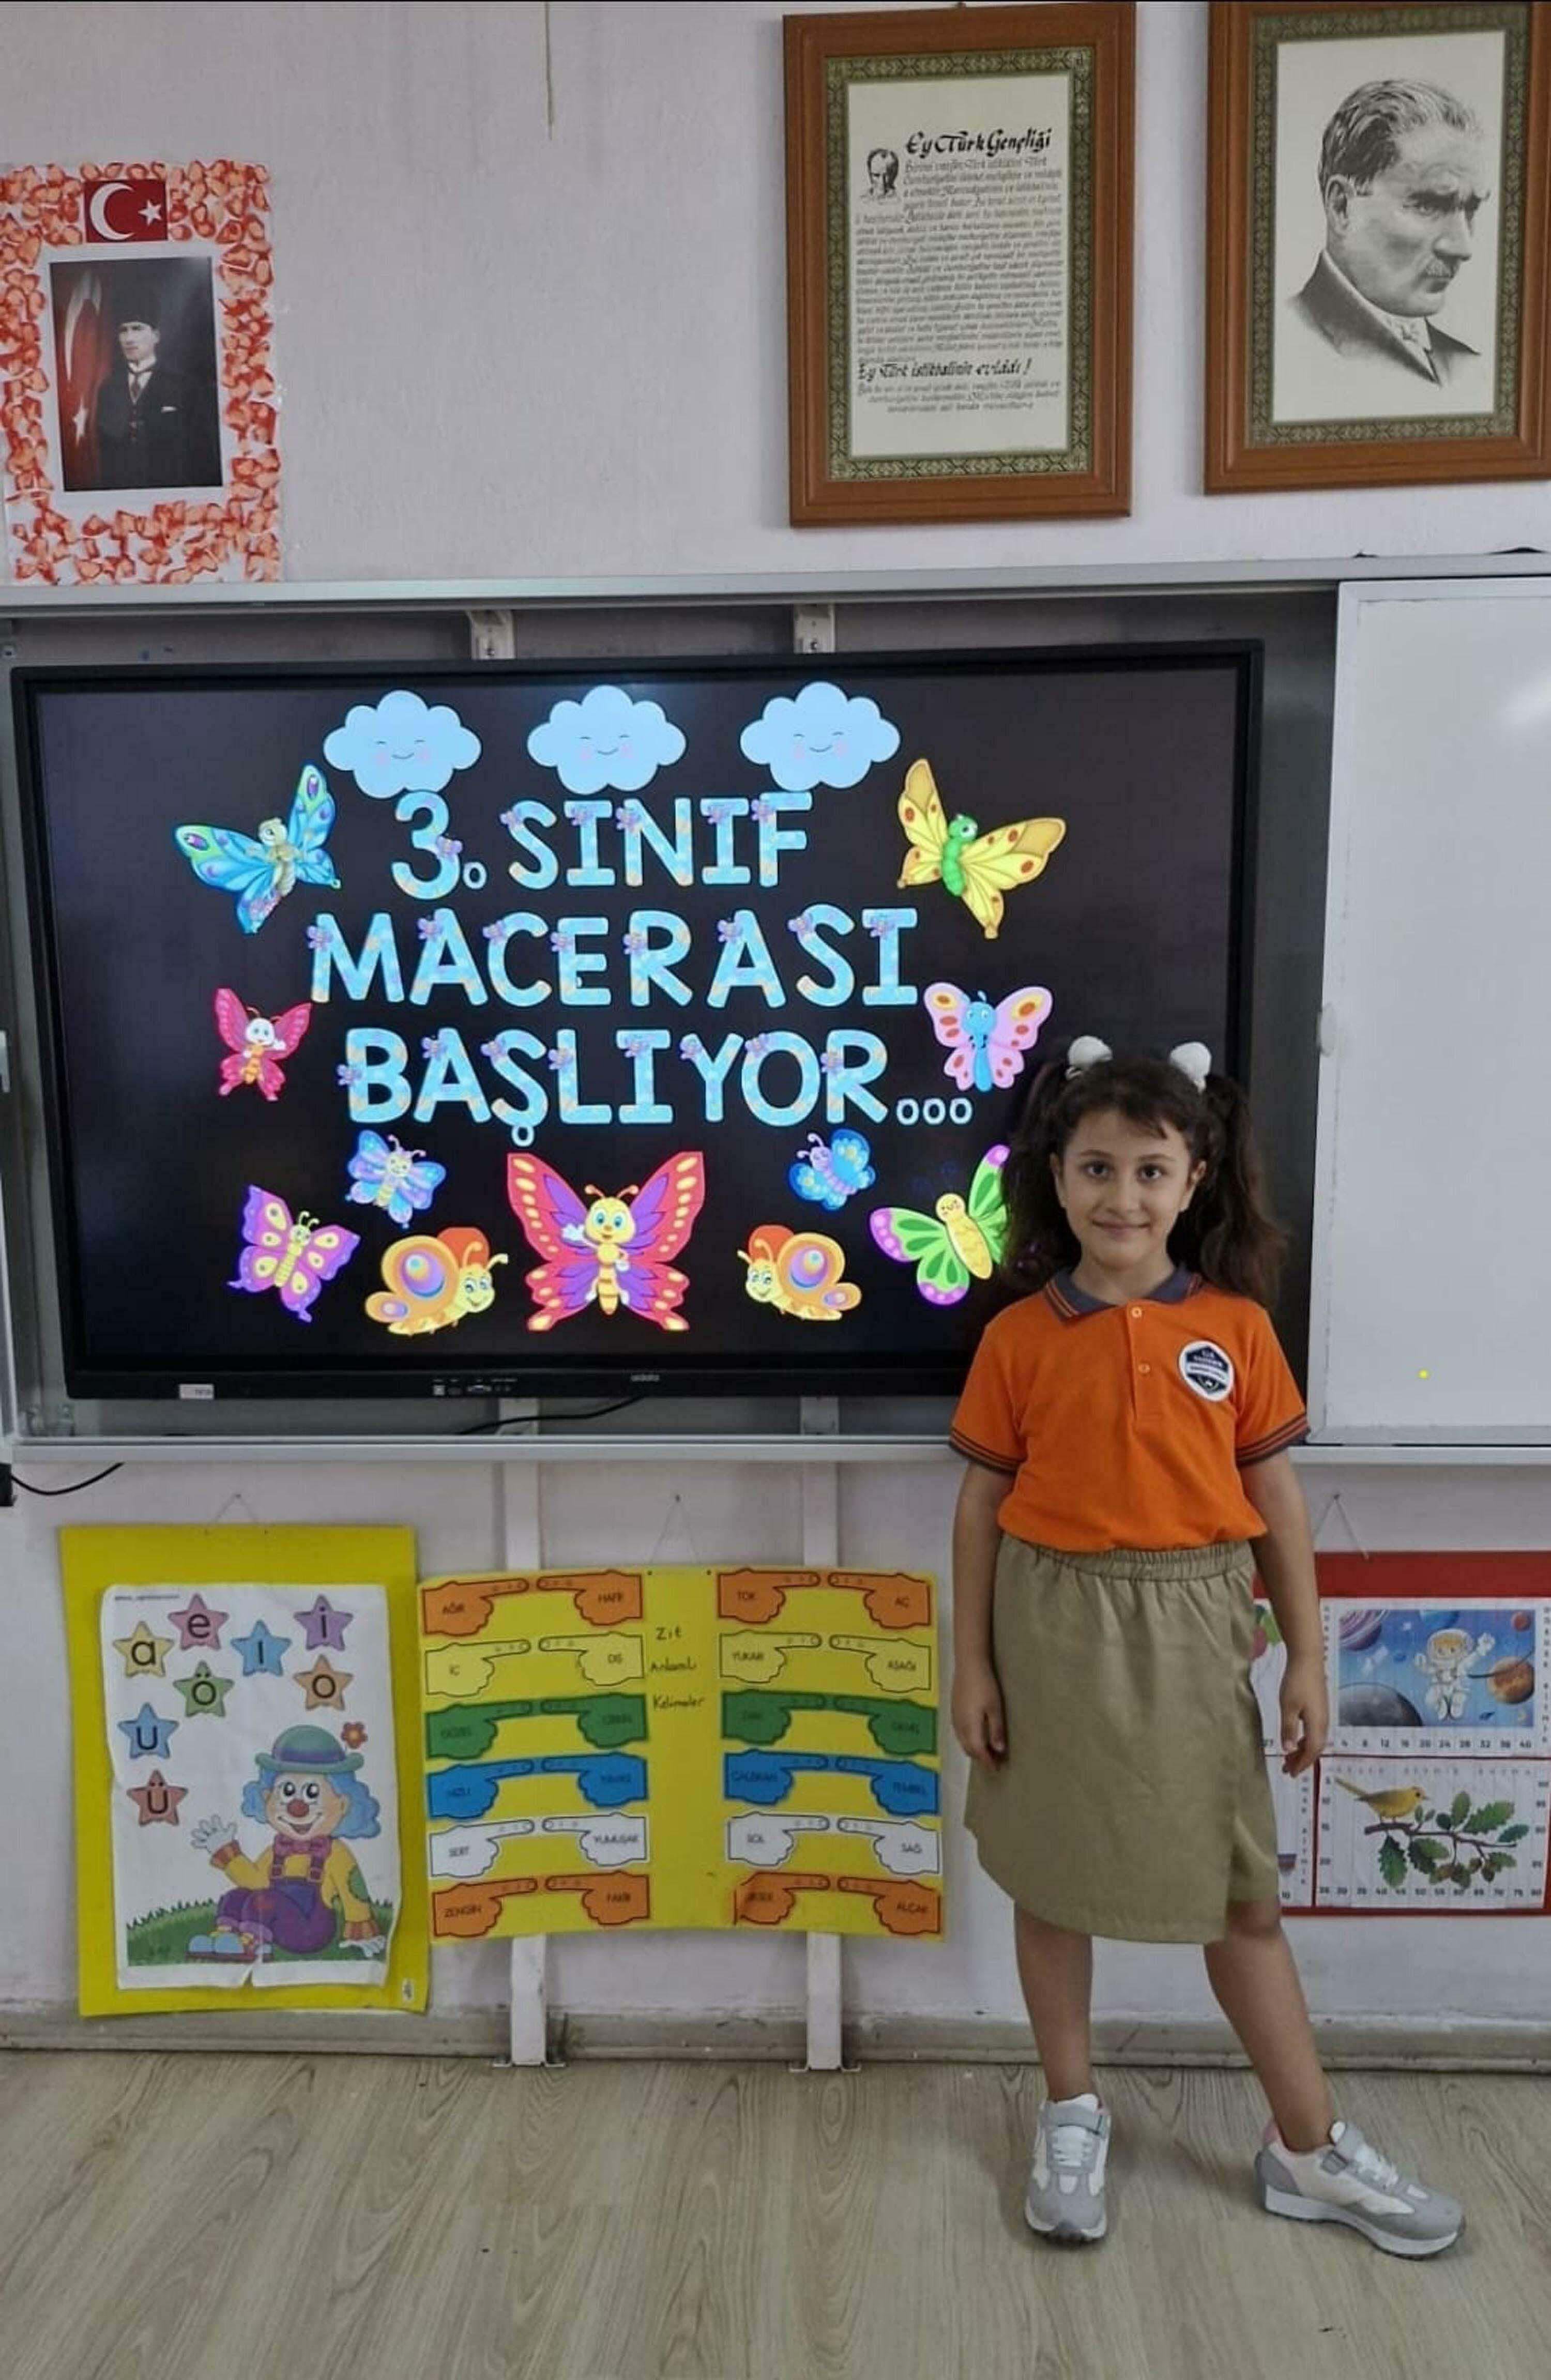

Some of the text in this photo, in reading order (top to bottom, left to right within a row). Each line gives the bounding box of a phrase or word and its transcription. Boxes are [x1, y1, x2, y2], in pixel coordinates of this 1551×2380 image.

[906, 131, 933, 159] Ey
[935, 130, 984, 154] Türk
[500, 792, 812, 890] SINIF
[308, 903, 918, 1008] MACERASI
[188, 1613, 210, 1638] e
[320, 1605, 327, 1638] i
[131, 1641, 156, 1666] a
[191, 1671, 216, 1706] ö
[312, 1674, 336, 1698] o
[137, 1727, 157, 1750] u
[147, 1781, 167, 1814] ü
